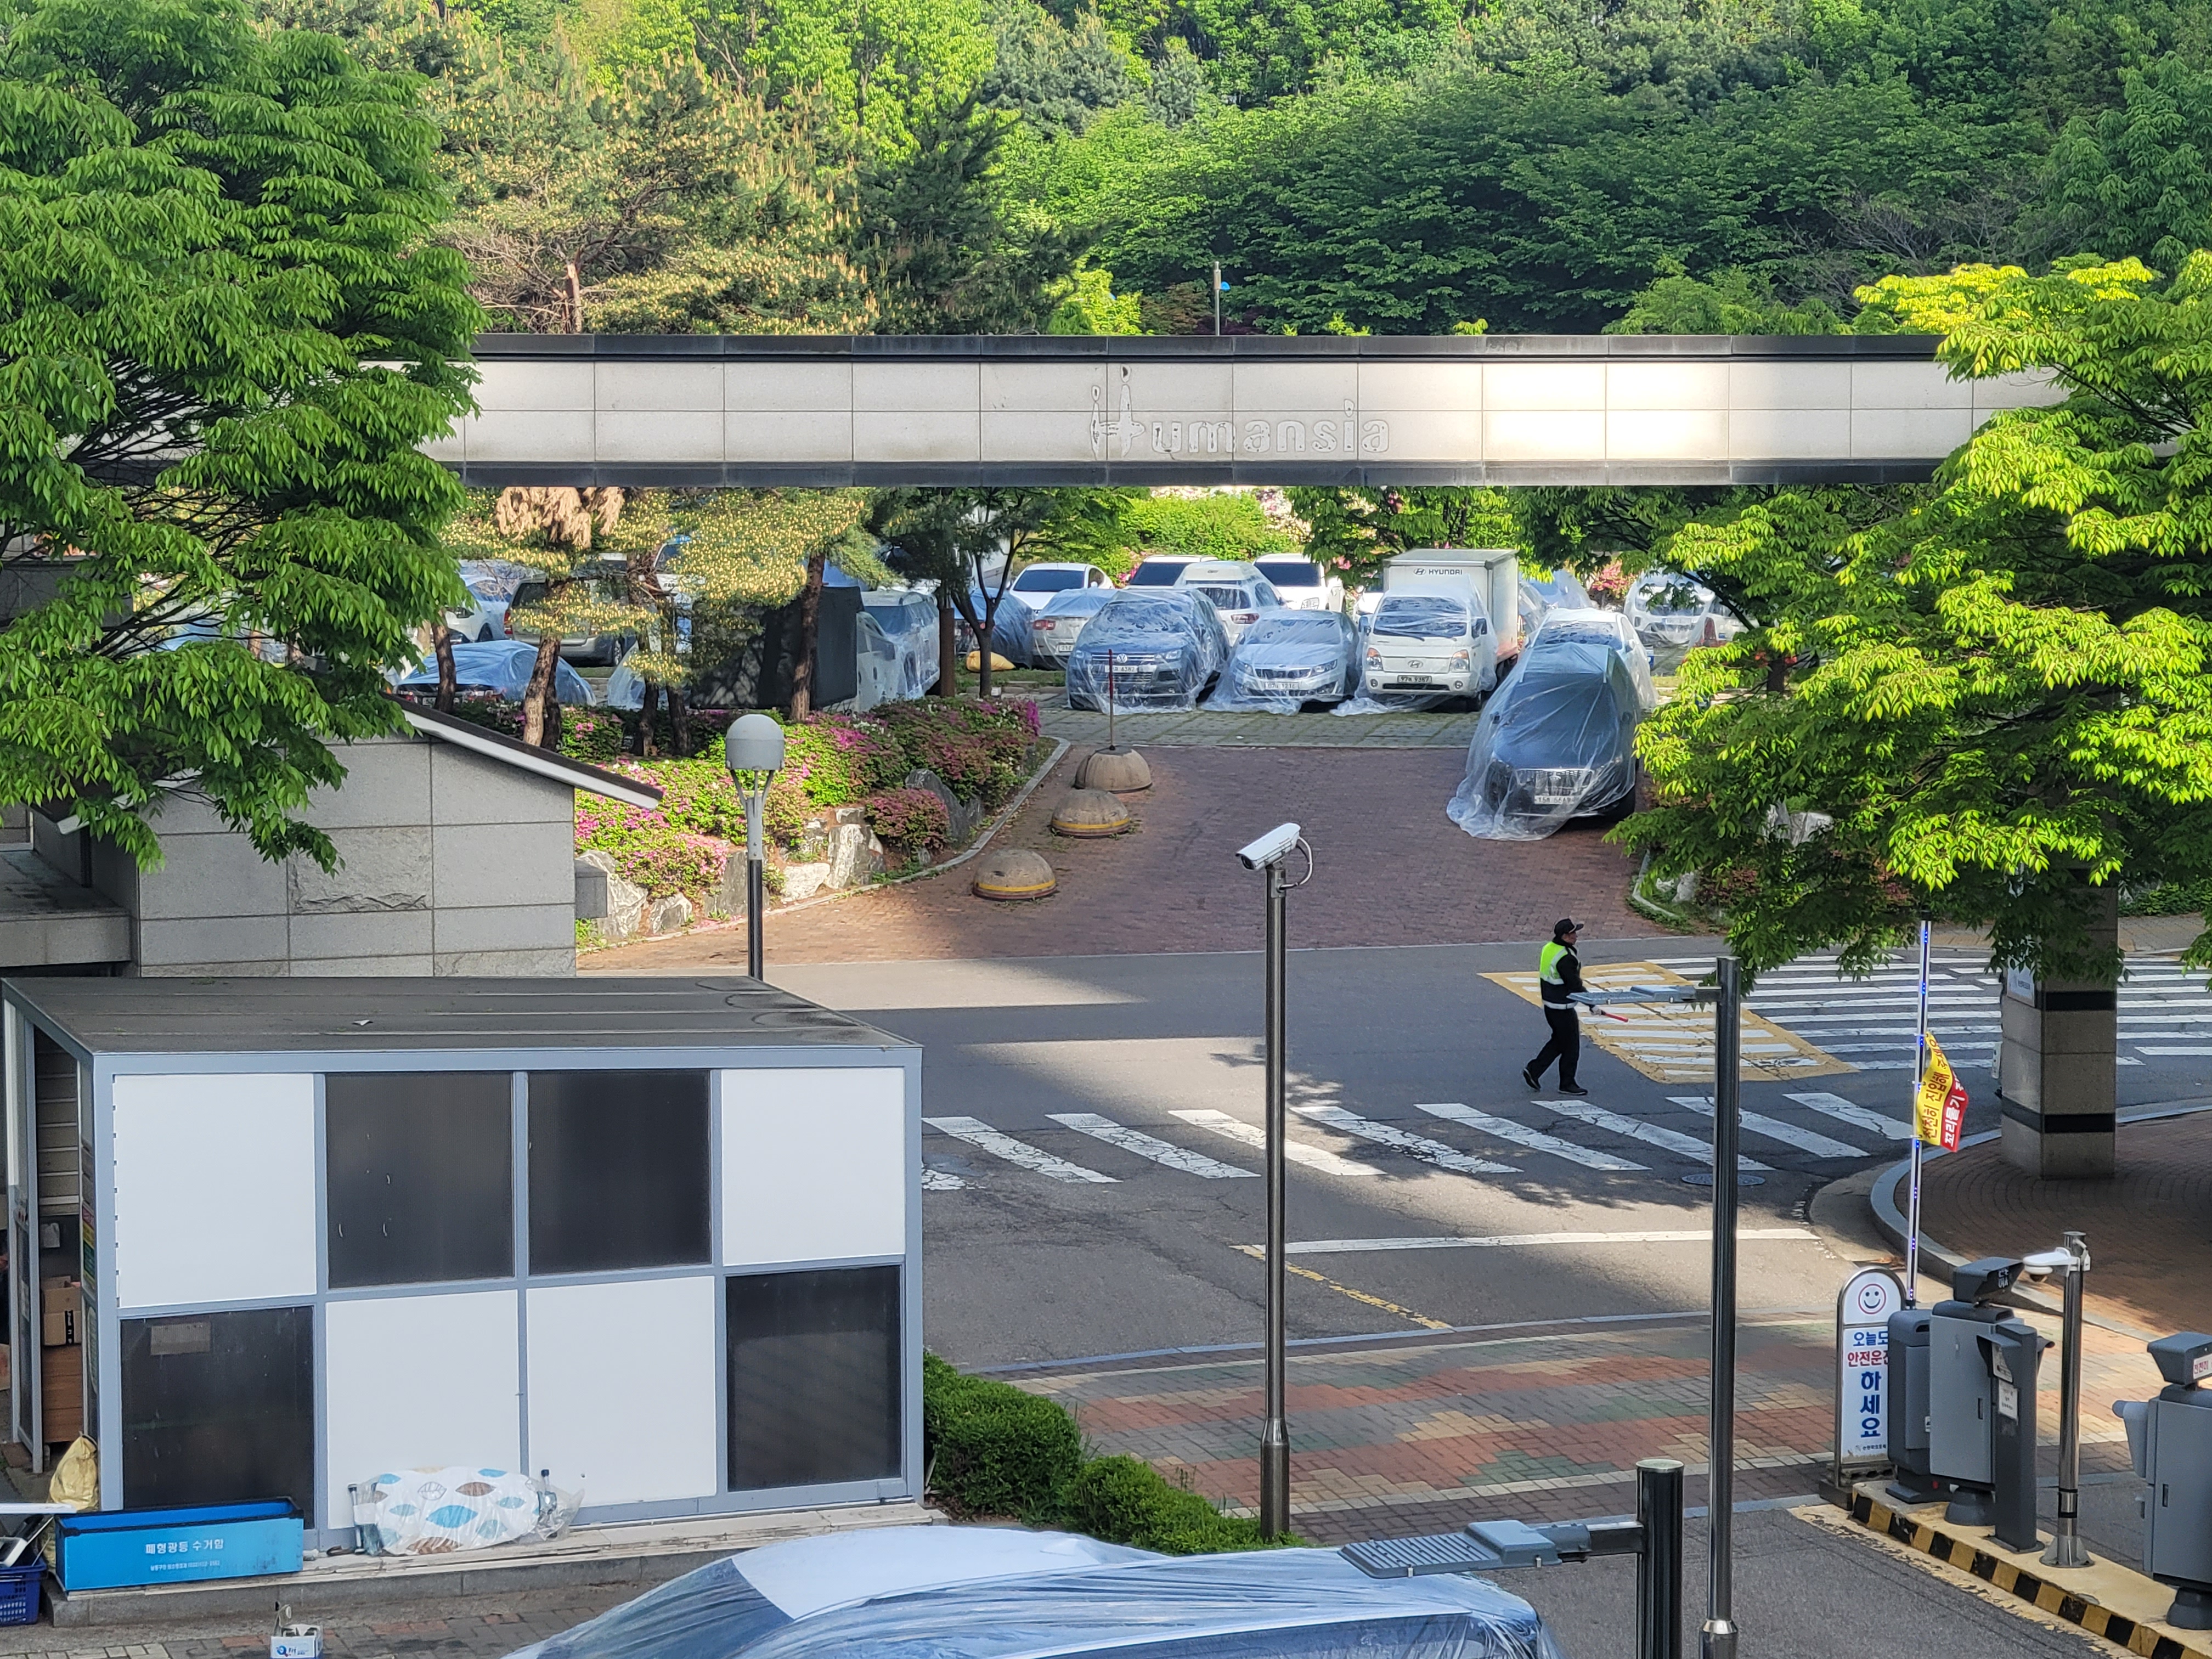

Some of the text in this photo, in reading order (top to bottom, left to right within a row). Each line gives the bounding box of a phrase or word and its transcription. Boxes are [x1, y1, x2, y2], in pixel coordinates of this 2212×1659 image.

[1926, 1071, 1950, 1102] 진입해
[1922, 1104, 1939, 1139] 천천히
[1945, 1095, 1965, 1148] 꼬리물기
[1853, 1331, 1888, 1346] 오늘도
[145, 1538, 224, 1554] 폐형광등 수거함
